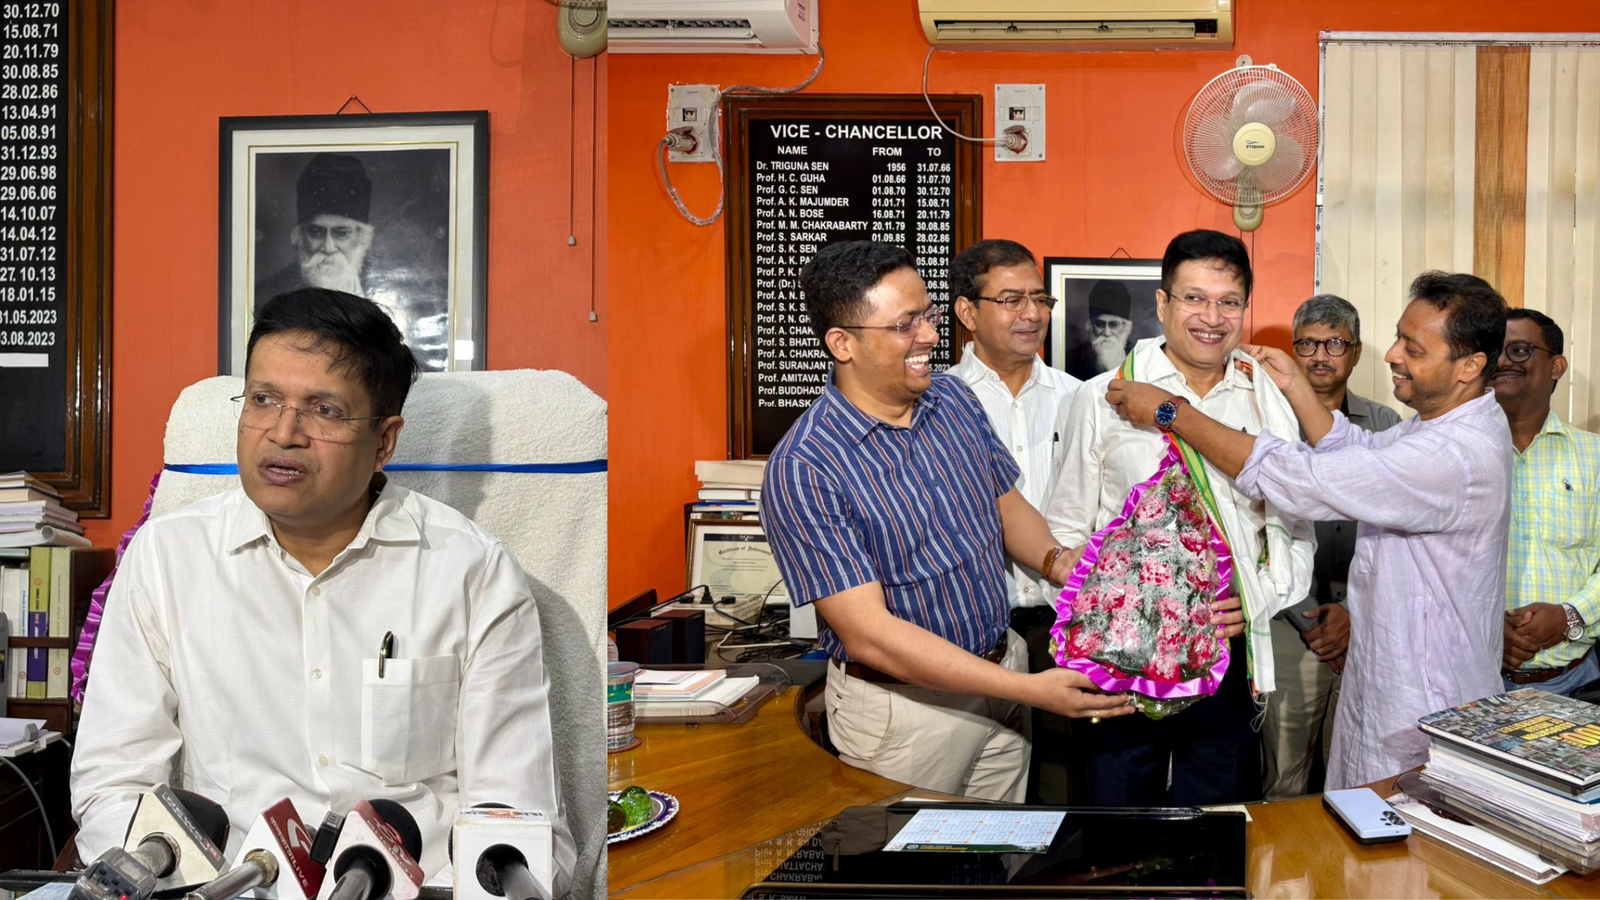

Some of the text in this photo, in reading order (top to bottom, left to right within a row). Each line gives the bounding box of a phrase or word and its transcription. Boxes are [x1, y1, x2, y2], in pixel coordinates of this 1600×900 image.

[4, 3, 59, 18] 30.12.70
[4, 22, 57, 38] 15.08.71
[4, 44, 58, 59] 20.11.79
[3, 64, 58, 79] 30.08.85
[2, 84, 58, 99] 28.02.86
[2, 105, 56, 119] 13.04.91
[1, 125, 55, 140] 05.08.91
[771, 125, 810, 138] VICE
[826, 124, 944, 139] CHANCELLOR
[1, 145, 56, 160] 31.12.93
[778, 146, 941, 156] NAME FROM TO
[757, 161, 950, 172] Dr. TRIGUNA SEN 1956 31.07.66
[1, 165, 56, 180] 29.06.98
[757, 173, 776, 181] Prof.
[789, 173, 797, 182] C.
[800, 174, 825, 182] GUHA
[873, 175, 906, 183] 01.08.66
[917, 175, 950, 183] 31.07.70
[1, 186, 56, 200] 29.06.06
[757, 185, 950, 195] Prof. G. C. SEN 01.08.70 30.12.70
[757, 197, 949, 207] Prof. A. K. MAJUMDER 01.01.71 15.08.71
[1, 206, 56, 220] 14.10.07
[757, 209, 950, 219] Prof. A. N. BOSE 16.08.71 20.11.79
[757, 220, 950, 231] Prof. M. M. CHAKRABARTY 20.11.79 30.08.85
[1, 226, 56, 241] 14.04.12
[757, 232, 949, 242] Prof. S. SARKAR 01.09.85 28.02.86
[0, 246, 55, 261] 31.07.12
[757, 244, 948, 254] Prof. S. K. SEN 13.04.91
[757, 256, 776, 264] Prof.
[778, 256, 786, 264] A.
[789, 256, 797, 264] K.
[916, 257, 948, 266] 05.08.91
[757, 267, 776, 276] Prof.
[779, 268, 785, 276] P.
[788, 268, 796, 276] K.
[757, 279, 776, 288] Prof.
[779, 279, 795, 291] (Dr.)
[0, 287, 55, 301] 18.01.15
[757, 291, 776, 299] Prof.
[778, 290, 787, 299] A.
[789, 290, 797, 299] N.
[757, 303, 776, 311] Prof.
[779, 303, 786, 311] S.
[789, 303, 797, 311] K.
[757, 314, 810, 323] Prof. P. N. GH
[758, 326, 814, 335] Prof. A. CHAK
[1, 331, 55, 345] 3.08.2023
[758, 338, 820, 346] Prof. S. BHATTA
[758, 349, 777, 358] Prof.
[790, 348, 830, 358] CHAKRA
[758, 361, 777, 369] Prof.
[779, 361, 826, 370] SURANJAN
[759, 374, 778, 382] Prof.
[781, 374, 819, 382] AMITAVA
[759, 399, 813, 408] Prof. BHASK
